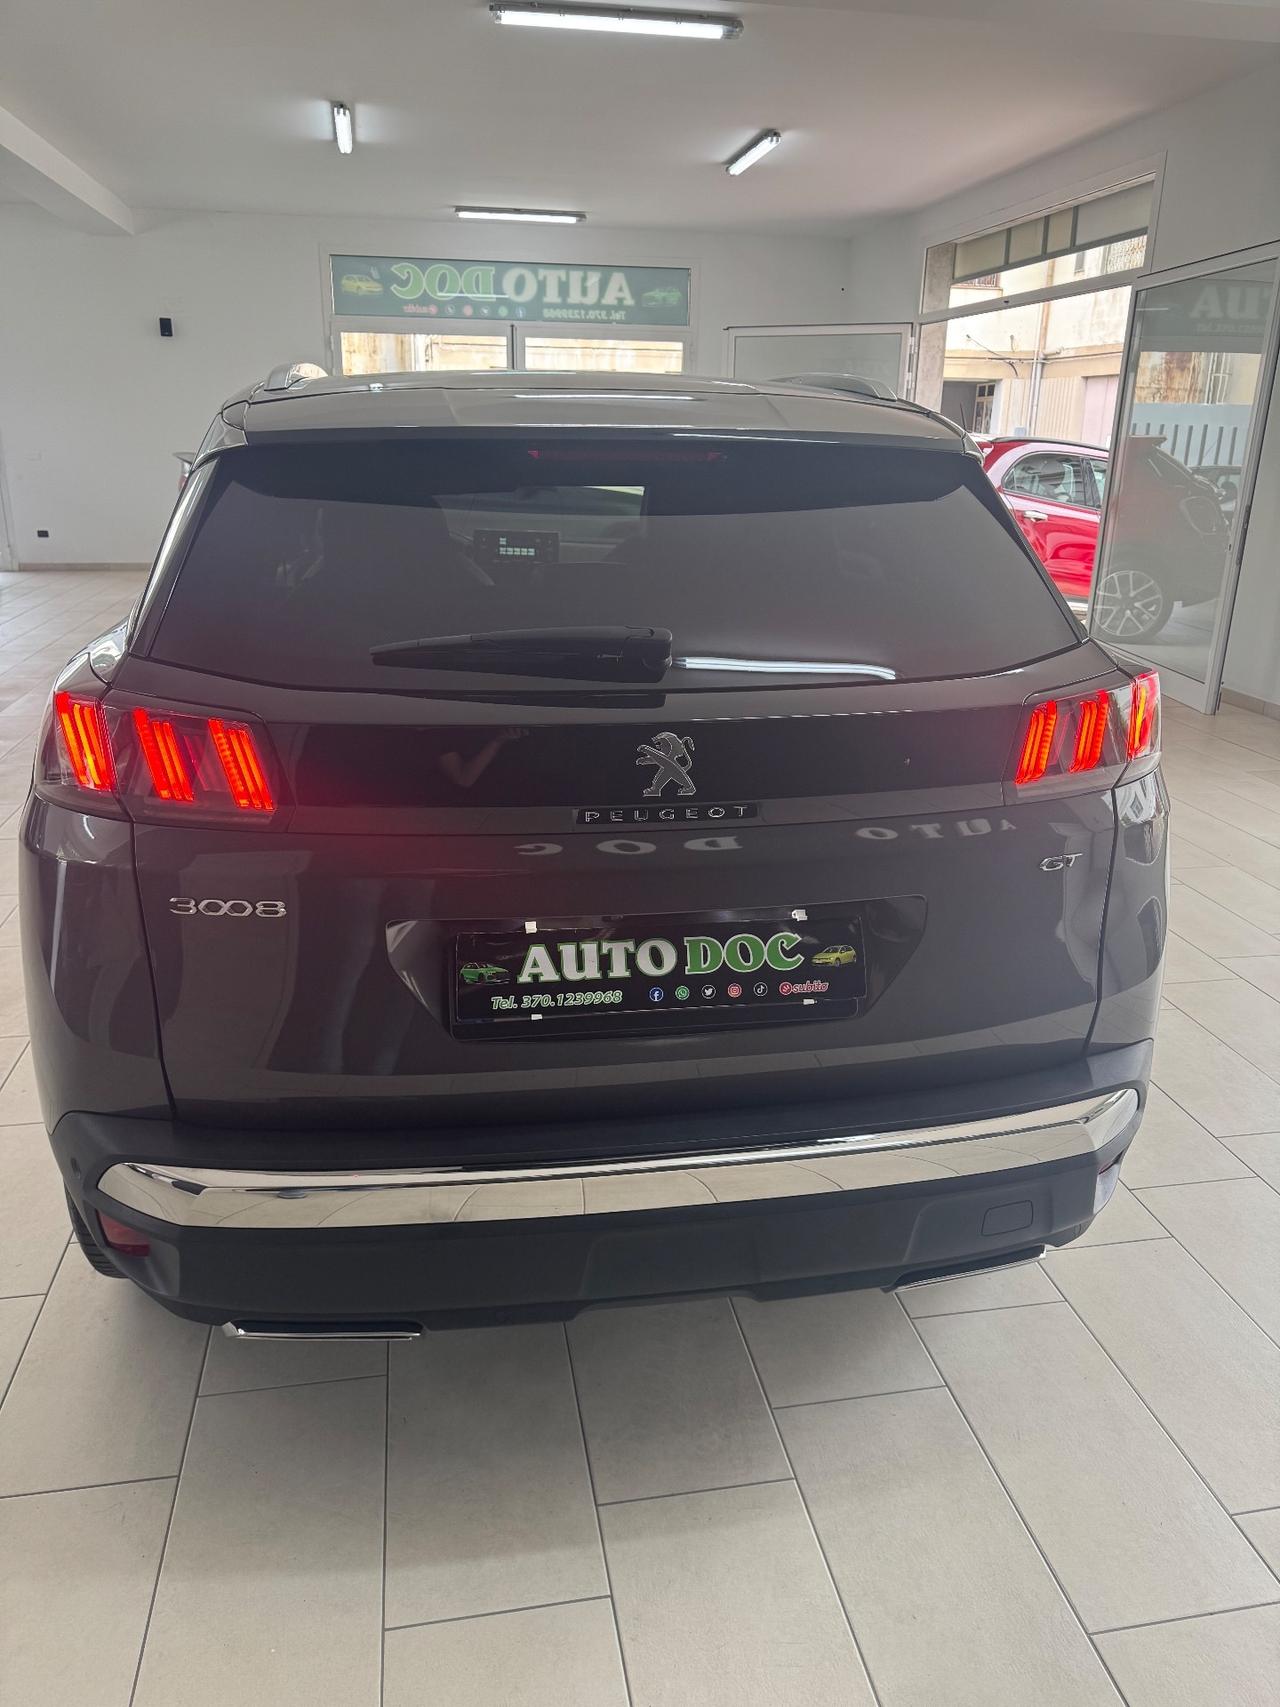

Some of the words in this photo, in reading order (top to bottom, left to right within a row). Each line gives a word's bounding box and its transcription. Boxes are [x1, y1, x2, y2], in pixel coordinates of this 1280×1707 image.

[584, 805, 748, 823] PEUGEOT
[1039, 852, 1083, 872] GT
[169, 897, 288, 918] 3008
[516, 937, 678, 984] AUTO
[684, 932, 805, 976] DOC
[792, 979, 830, 994] subito
[490, 995, 519, 1010] Tel.
[520, 989, 624, 1009] 370.1239968
